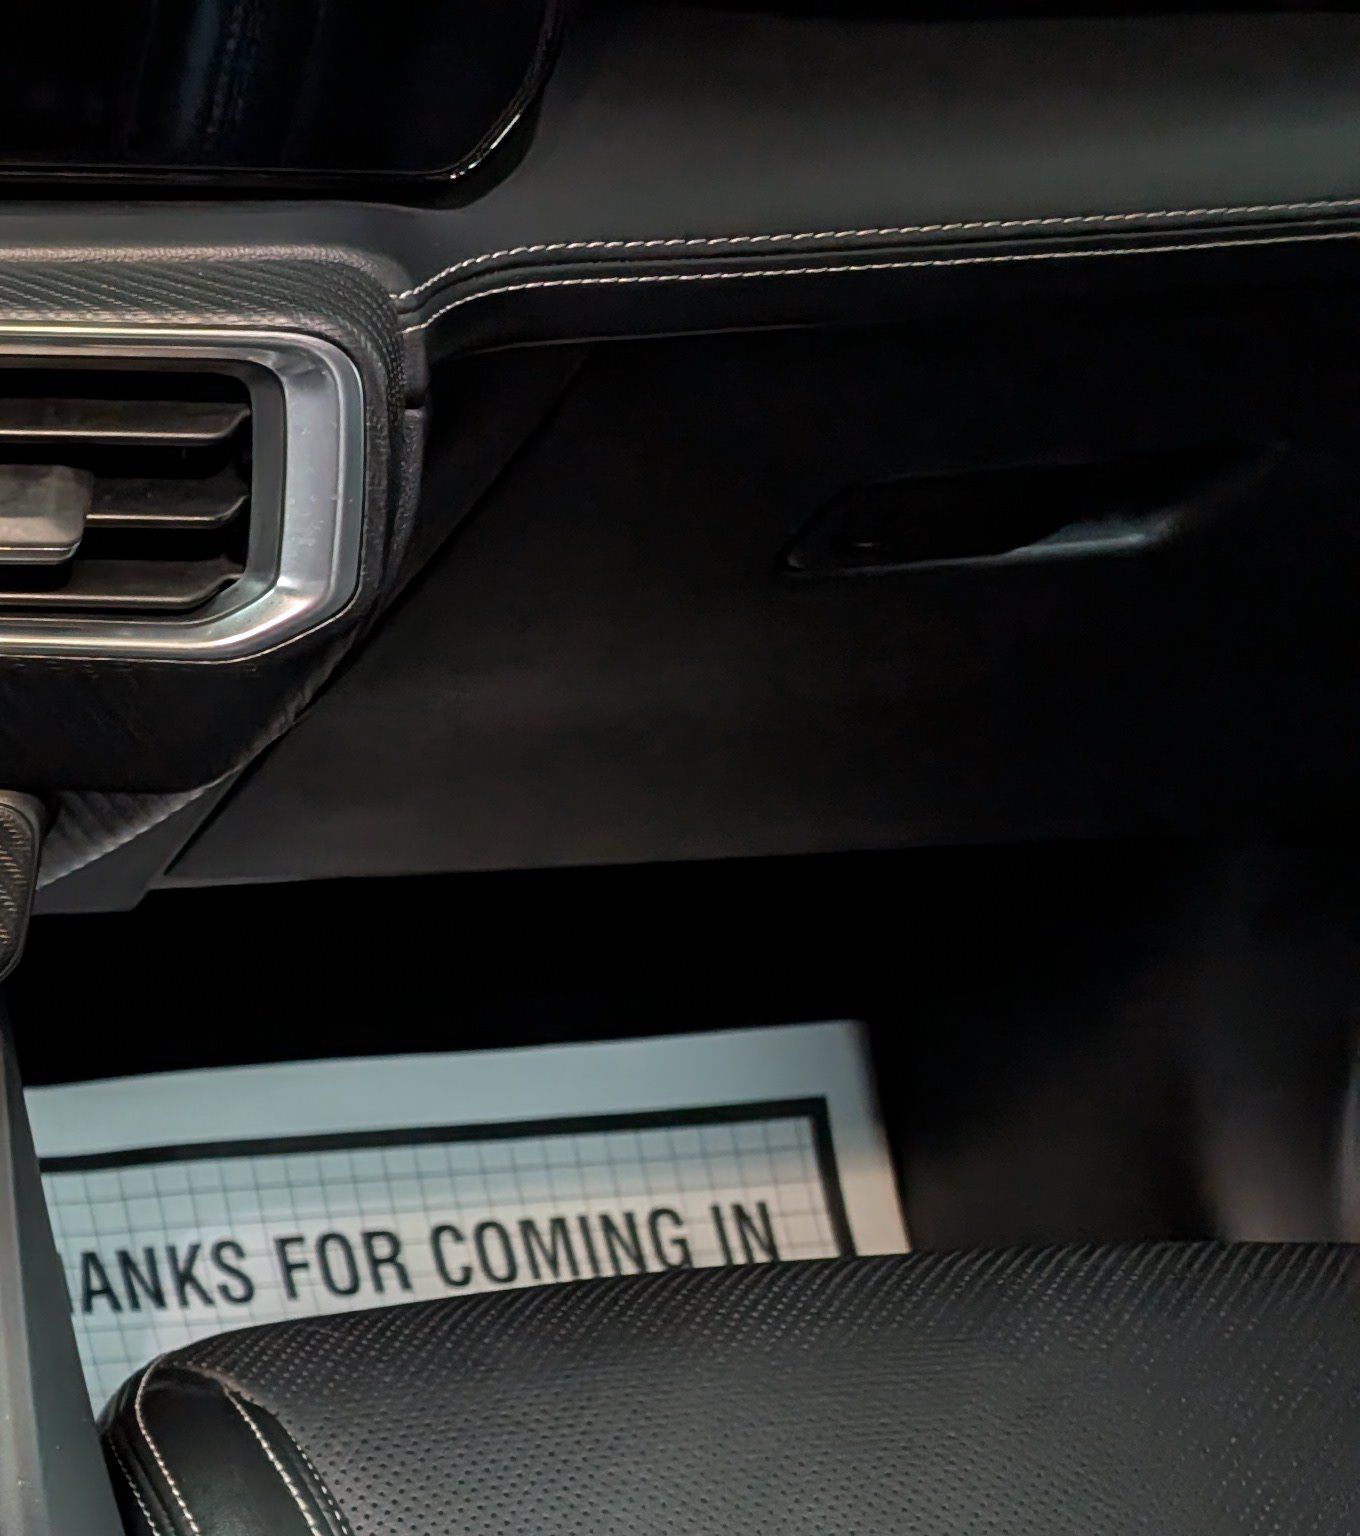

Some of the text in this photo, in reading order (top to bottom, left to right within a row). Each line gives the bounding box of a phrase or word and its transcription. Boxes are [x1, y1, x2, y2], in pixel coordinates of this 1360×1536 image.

[70, 1202, 780, 1313] ANKS FOR COMING IN
